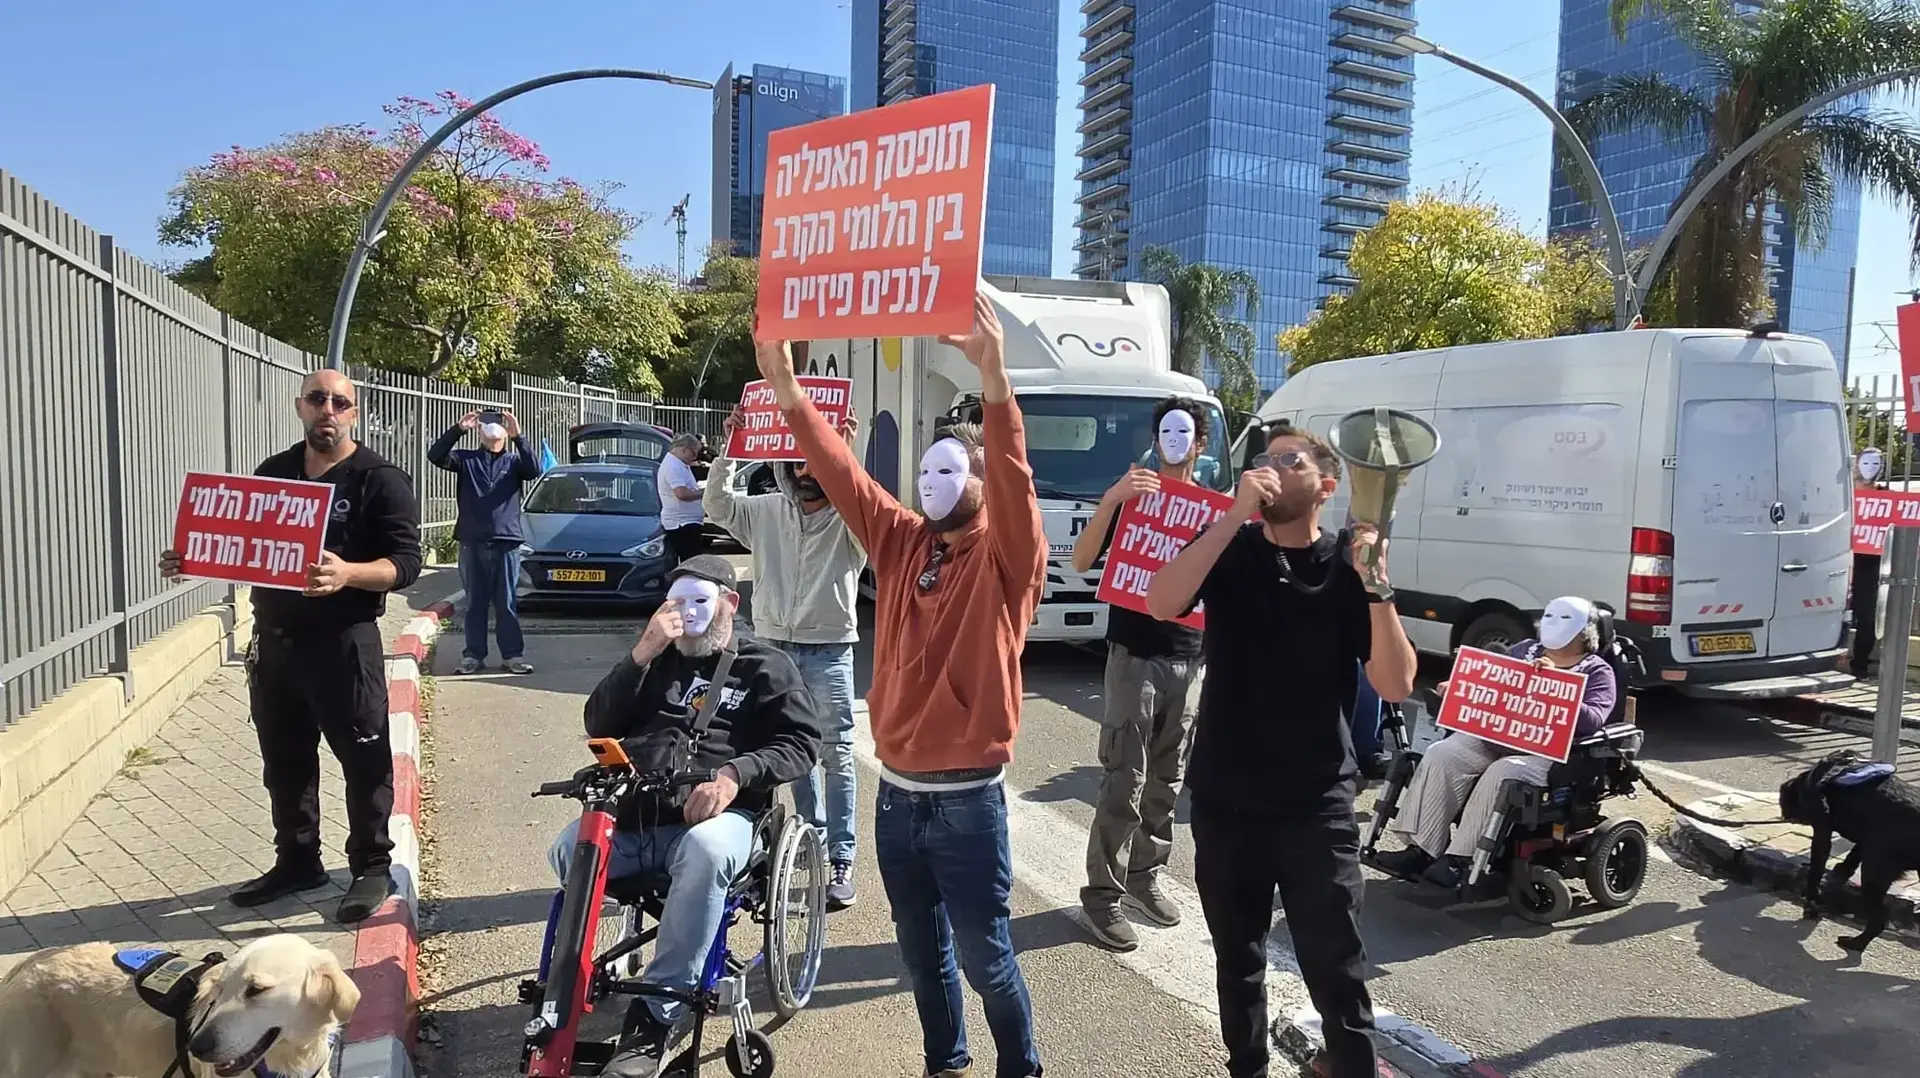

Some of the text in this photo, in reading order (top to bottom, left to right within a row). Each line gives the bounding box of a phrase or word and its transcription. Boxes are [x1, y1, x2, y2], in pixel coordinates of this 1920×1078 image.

[758, 81, 798, 102] align
[775, 120, 971, 199] תופסק האפליה
[771, 192, 964, 265] בין הלומי הקרב
[782, 256, 941, 320] לנכים פיזיים
[743, 386, 845, 408] תופס פלייה
[744, 434, 781, 451] פיזיים
[189, 483, 320, 529] אפליית הלומי
[1163, 494, 1212, 531] לתקן
[184, 531, 305, 577] הקרב הורגת
[1458, 656, 1578, 702] תופסק האפלייה
[1454, 679, 1569, 726] בין הלומי הקרב
[1457, 704, 1554, 747] לנכים פיזיים
